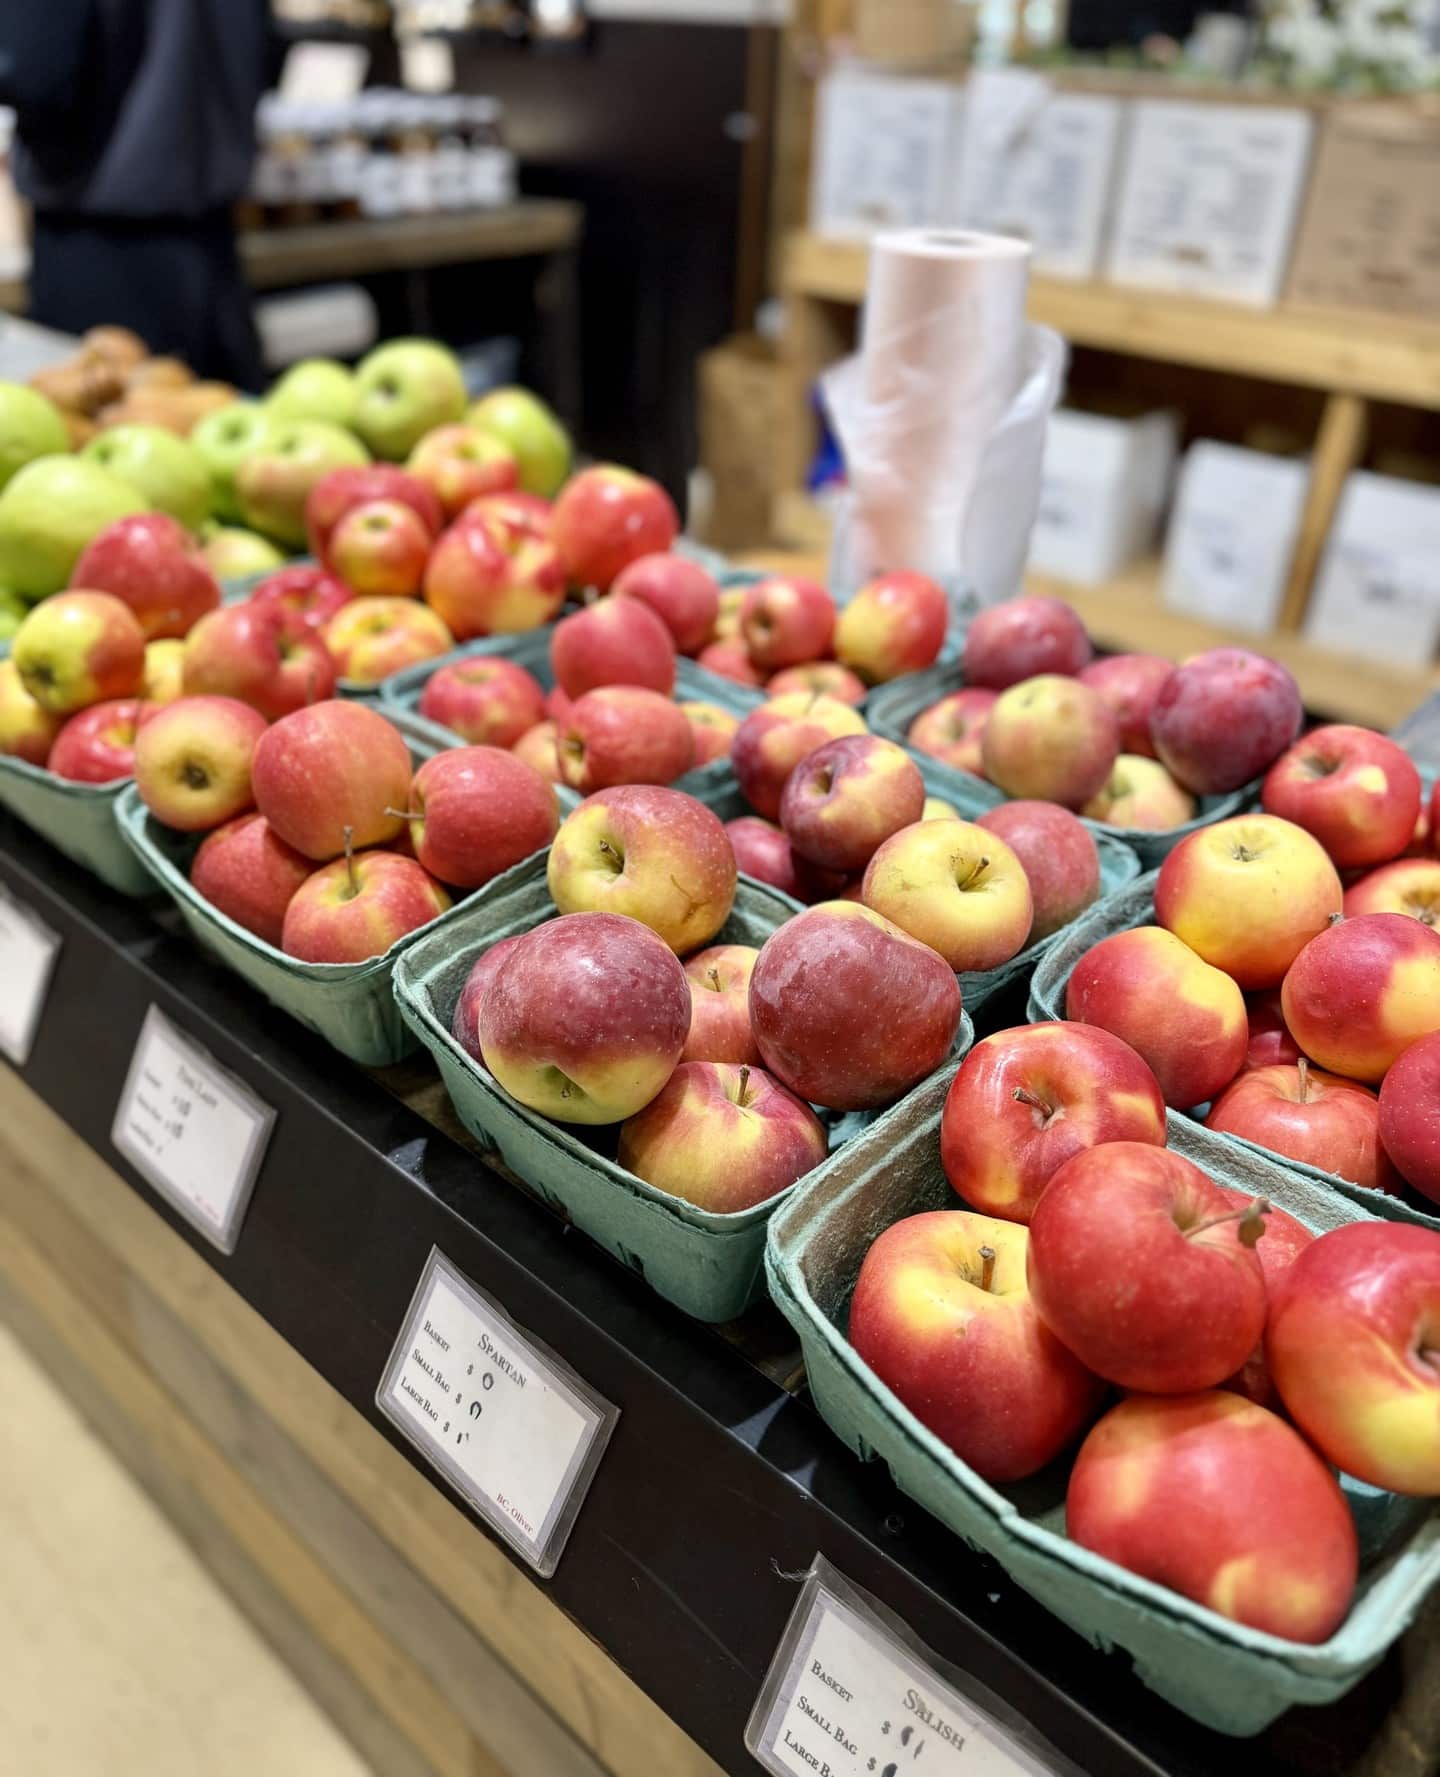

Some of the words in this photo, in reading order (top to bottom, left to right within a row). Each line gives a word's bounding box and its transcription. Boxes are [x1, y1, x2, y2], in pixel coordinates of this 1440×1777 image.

[424, 1320, 450, 1352] BASKET
[412, 1348, 434, 1378] SMALL
[434, 1372, 450, 1392] BAG
[477, 1334, 527, 1388] SPARTAN
[401, 1376, 424, 1406] LARGE
[423, 1399, 439, 1422] BAG
[811, 1660, 853, 1703] BASKET
[797, 1695, 832, 1735] SMALL
[833, 1726, 858, 1755] BAG
[902, 1688, 966, 1752] SALISH
[784, 1729, 818, 1770] LARGE
